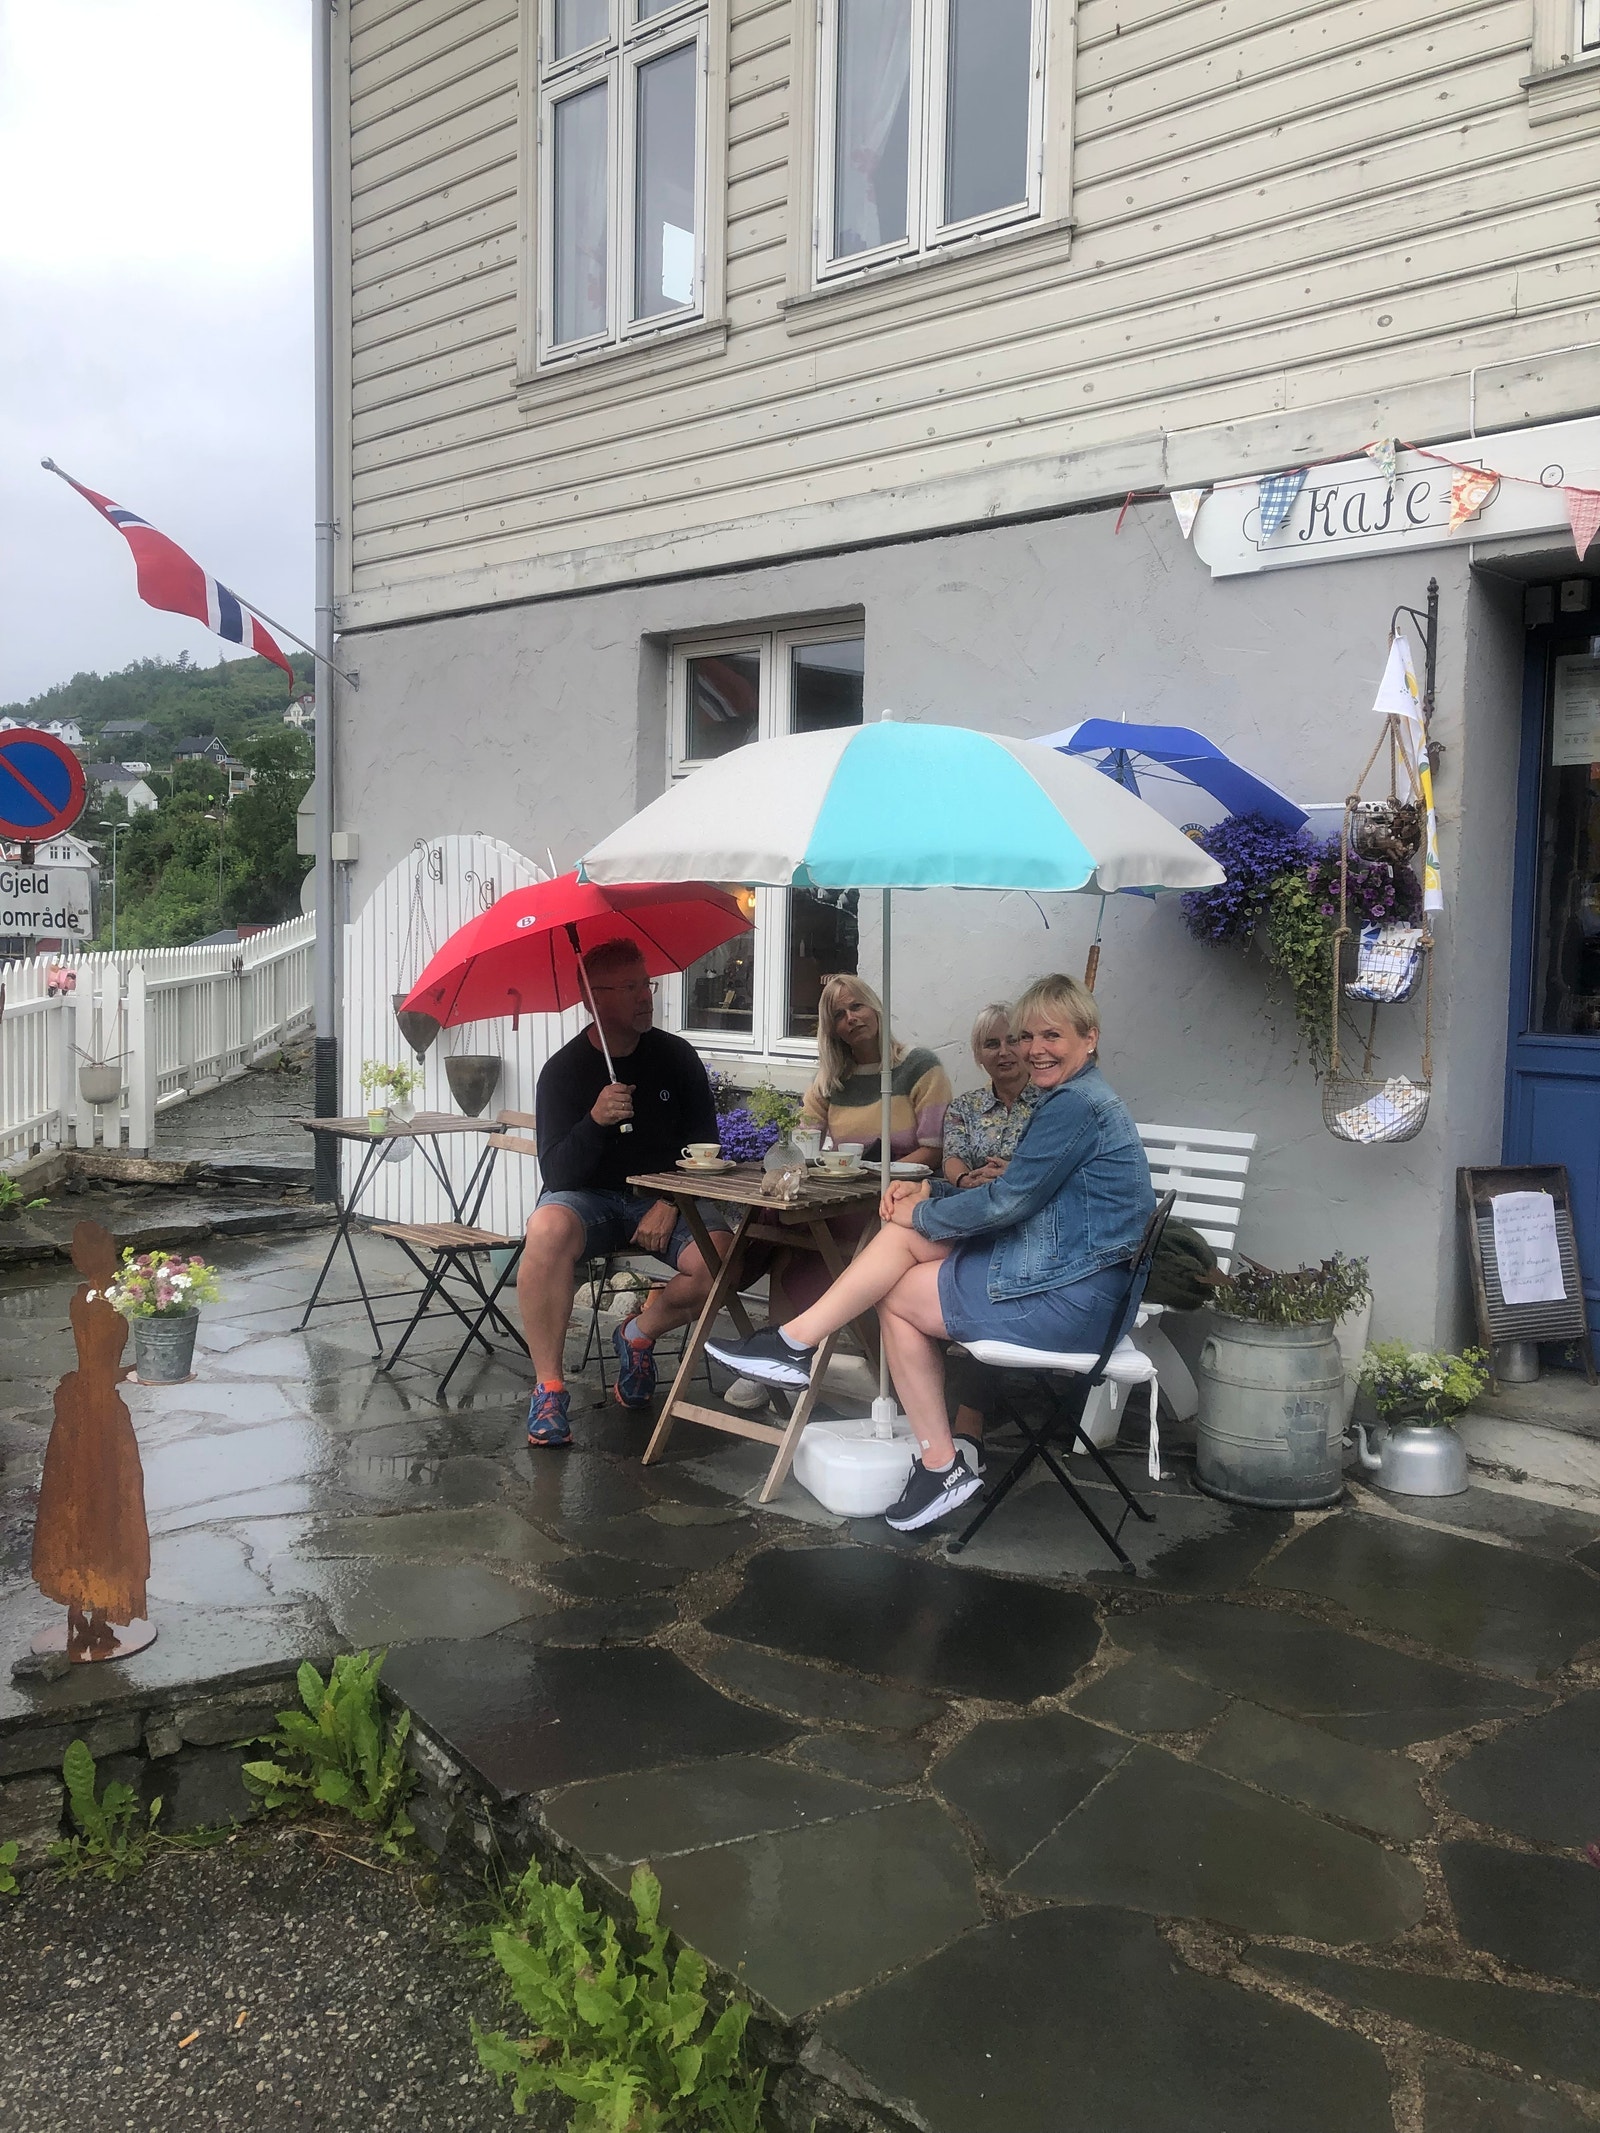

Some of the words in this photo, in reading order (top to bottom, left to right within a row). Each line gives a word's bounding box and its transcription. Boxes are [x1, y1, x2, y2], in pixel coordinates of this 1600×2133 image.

[1298, 477, 1431, 541] Kafe
[0, 871, 49, 898] Gjeld
[0, 906, 79, 929] område
[942, 1465, 966, 1490] HOKA
